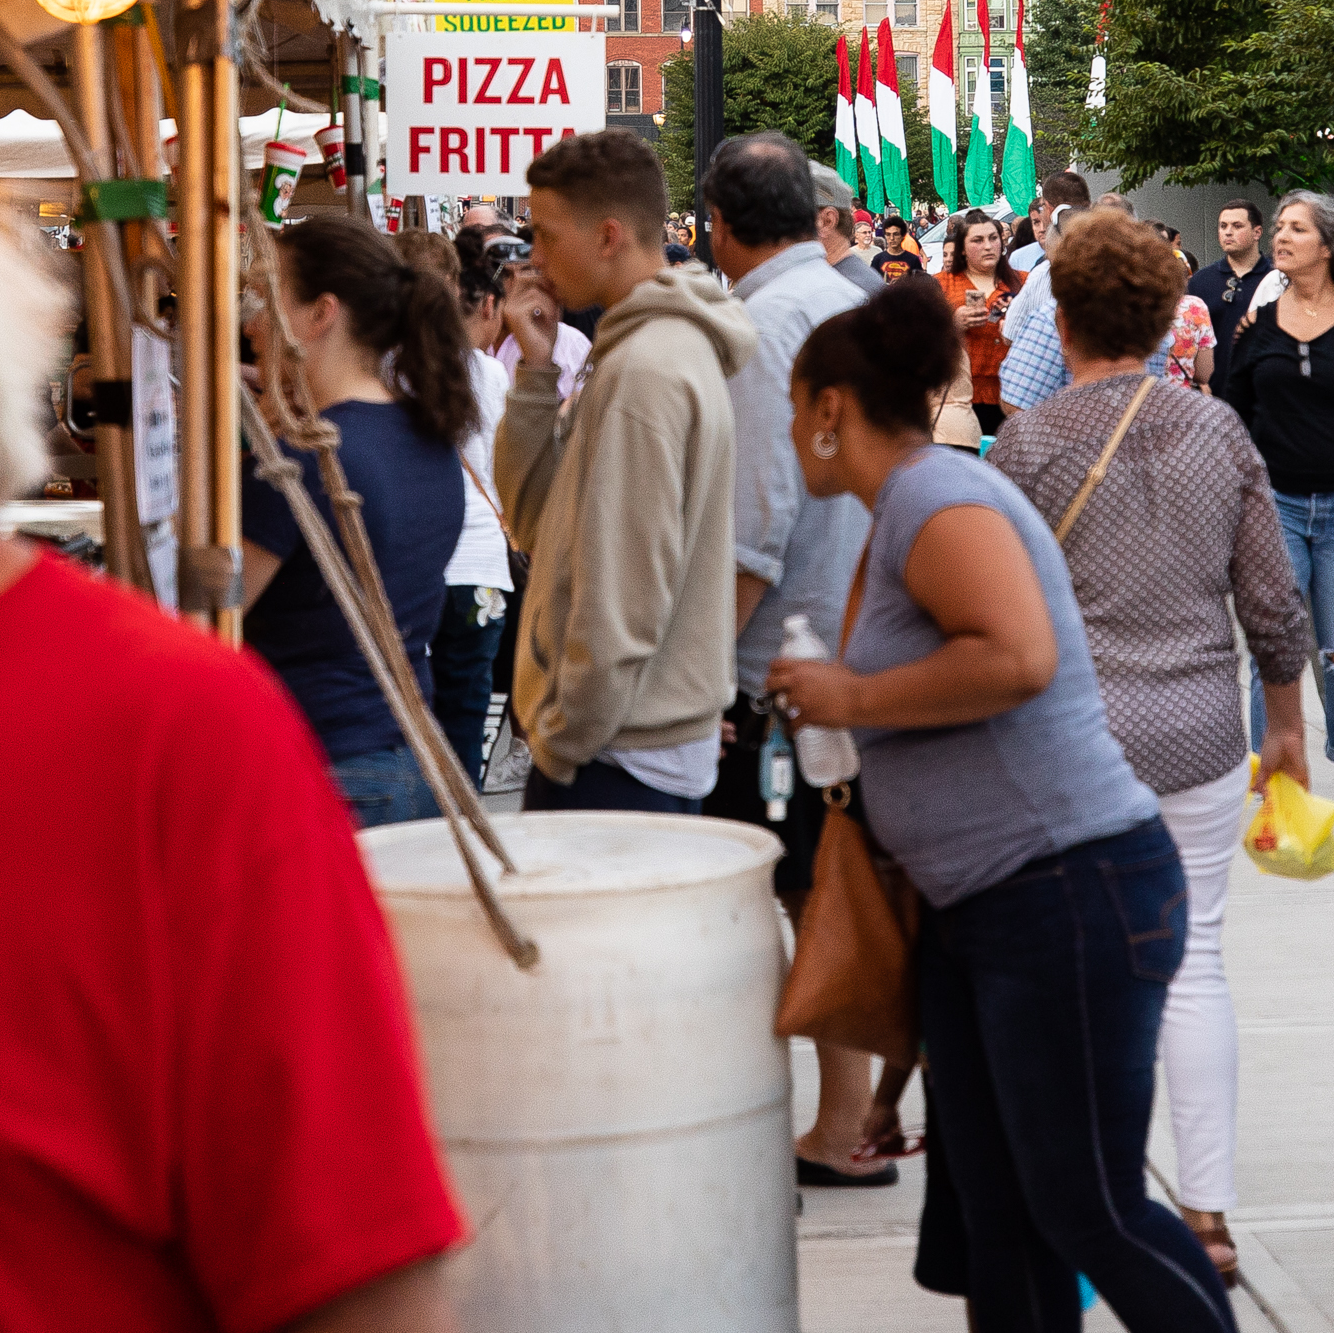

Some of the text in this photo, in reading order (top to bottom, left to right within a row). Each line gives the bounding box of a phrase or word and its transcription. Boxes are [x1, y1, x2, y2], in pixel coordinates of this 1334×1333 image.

[444, 14, 567, 33] SQUEEZED
[423, 56, 571, 105] PIZZA
[408, 126, 577, 174] FRITT
